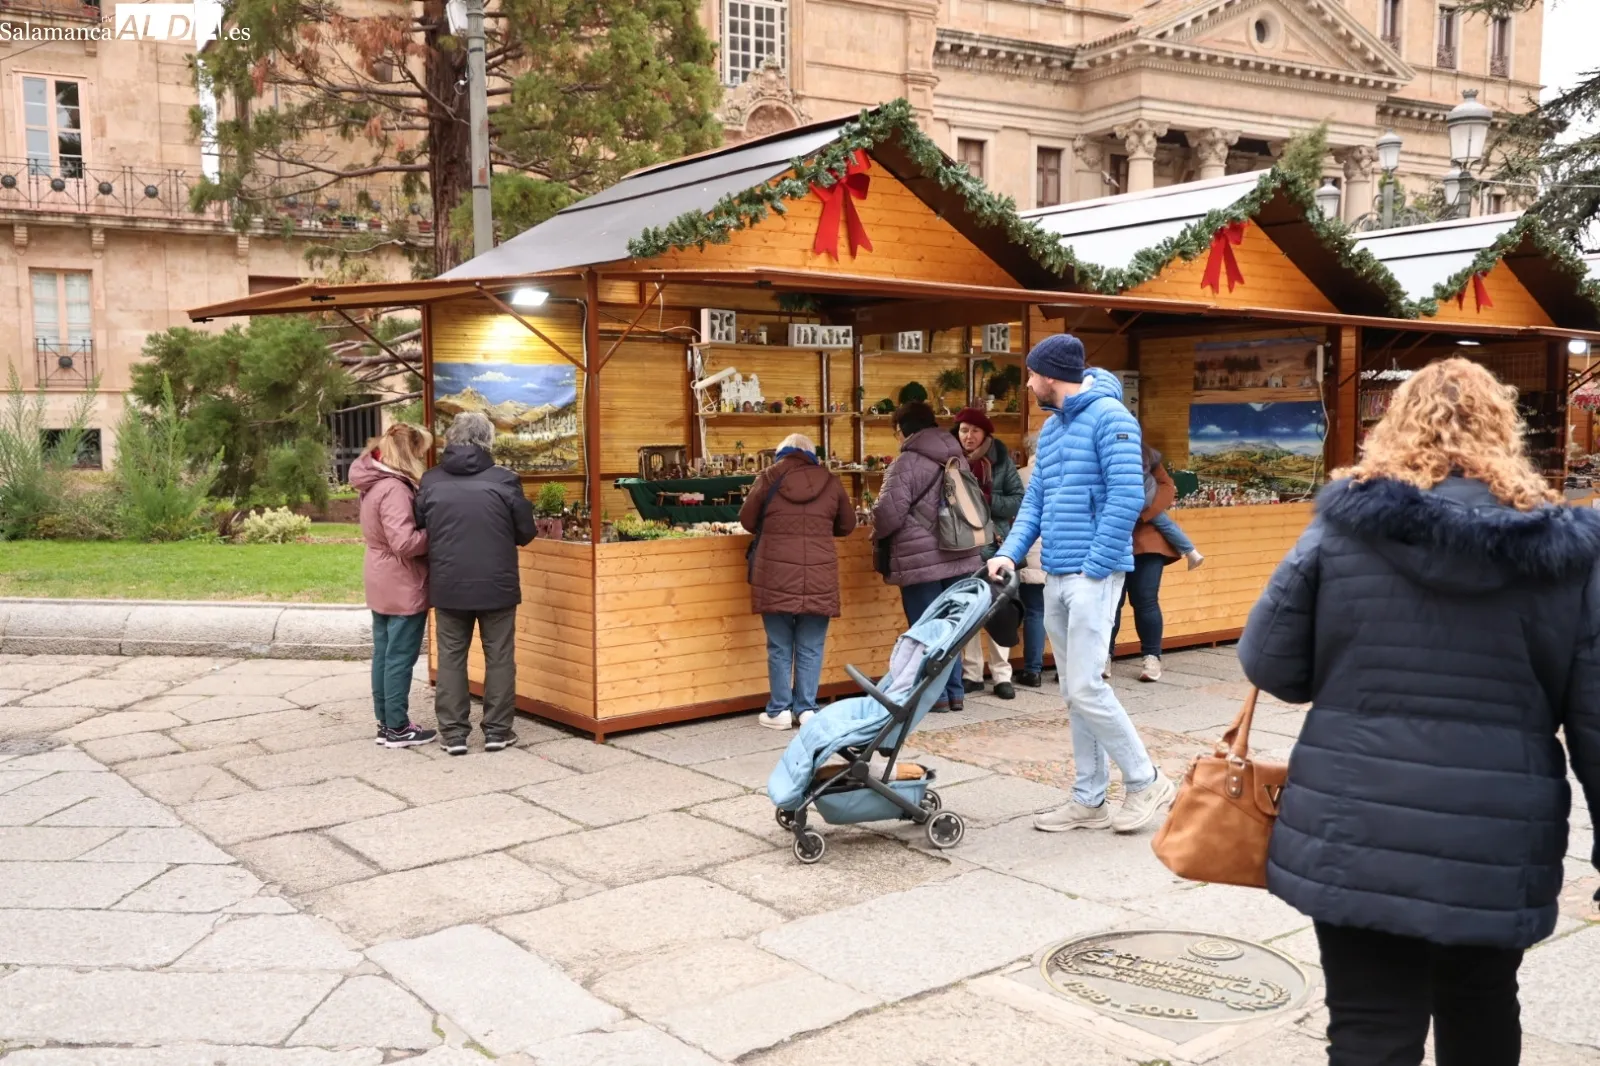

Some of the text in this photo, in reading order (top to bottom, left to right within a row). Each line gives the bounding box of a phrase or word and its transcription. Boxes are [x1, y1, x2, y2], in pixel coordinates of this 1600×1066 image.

[1081, 952, 1267, 998] SALAMANCA
[1115, 968, 1212, 993] PATRIMONIO
[1127, 977, 1228, 1002] HUMANIDAD
[1063, 979, 1111, 1003] 1988
[1125, 1003, 1198, 1019] 2008
